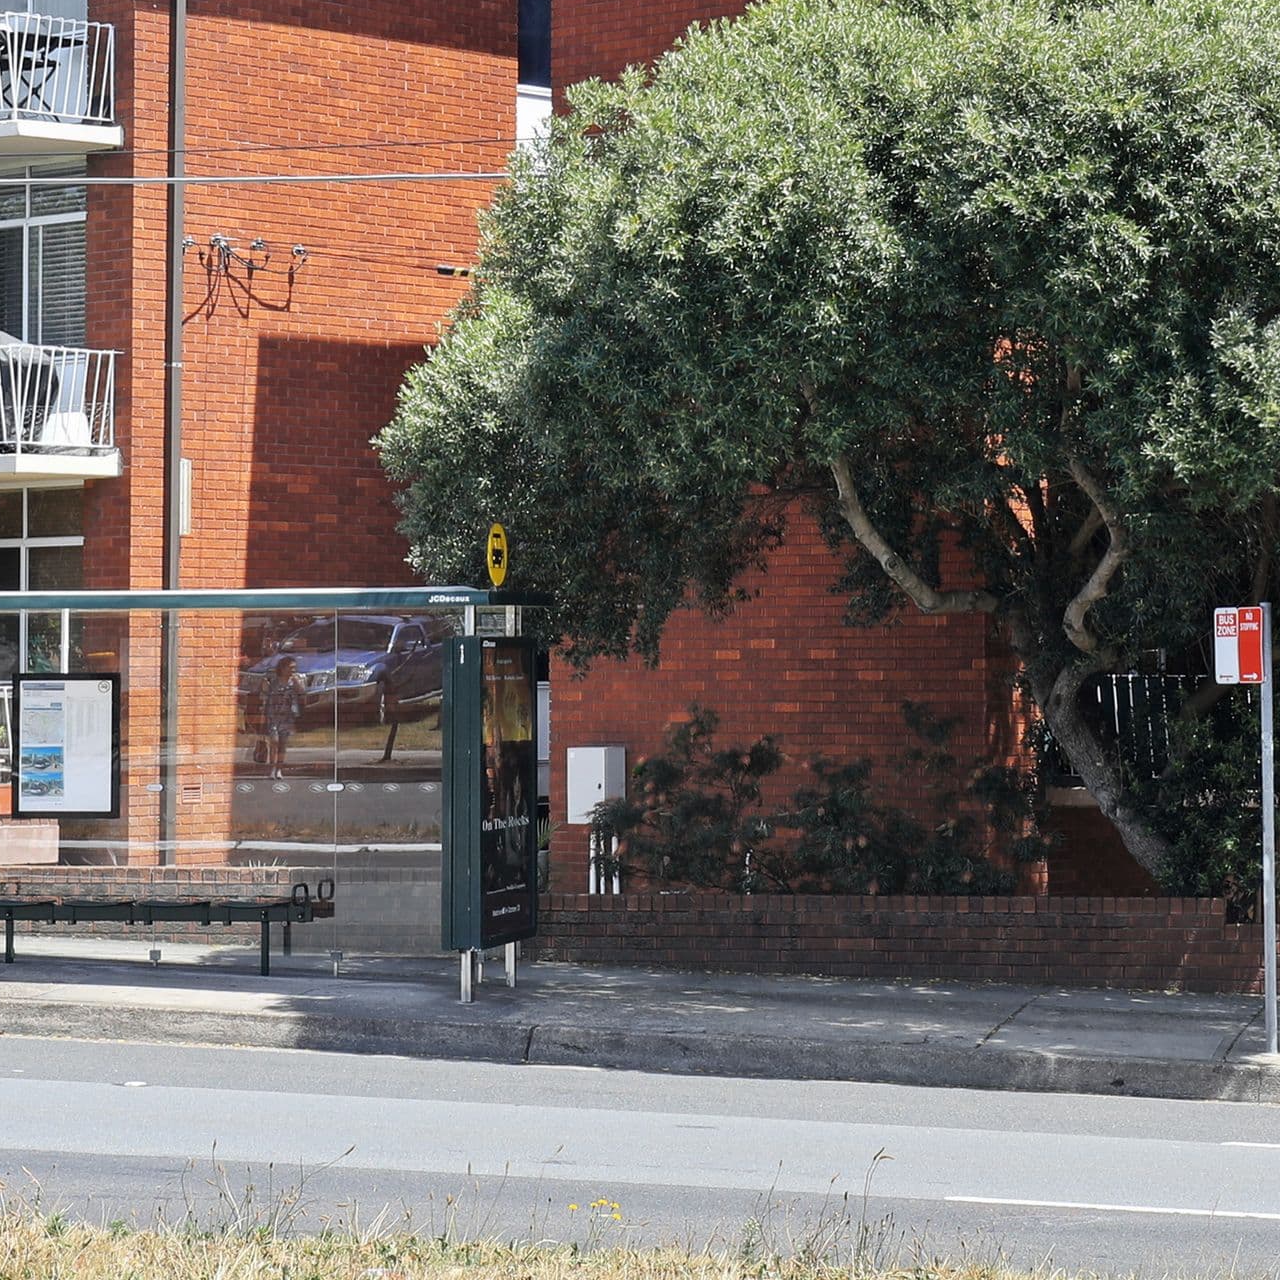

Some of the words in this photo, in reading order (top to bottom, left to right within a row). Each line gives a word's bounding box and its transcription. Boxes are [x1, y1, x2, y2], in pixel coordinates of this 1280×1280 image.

[428, 594, 470, 603] JCDecaux
[1218, 614, 1234, 625] BUS
[1217, 625, 1237, 636] ZONE
[482, 820, 493, 831] On
[493, 818, 507, 830] The
[508, 815, 530, 827] Rocks
